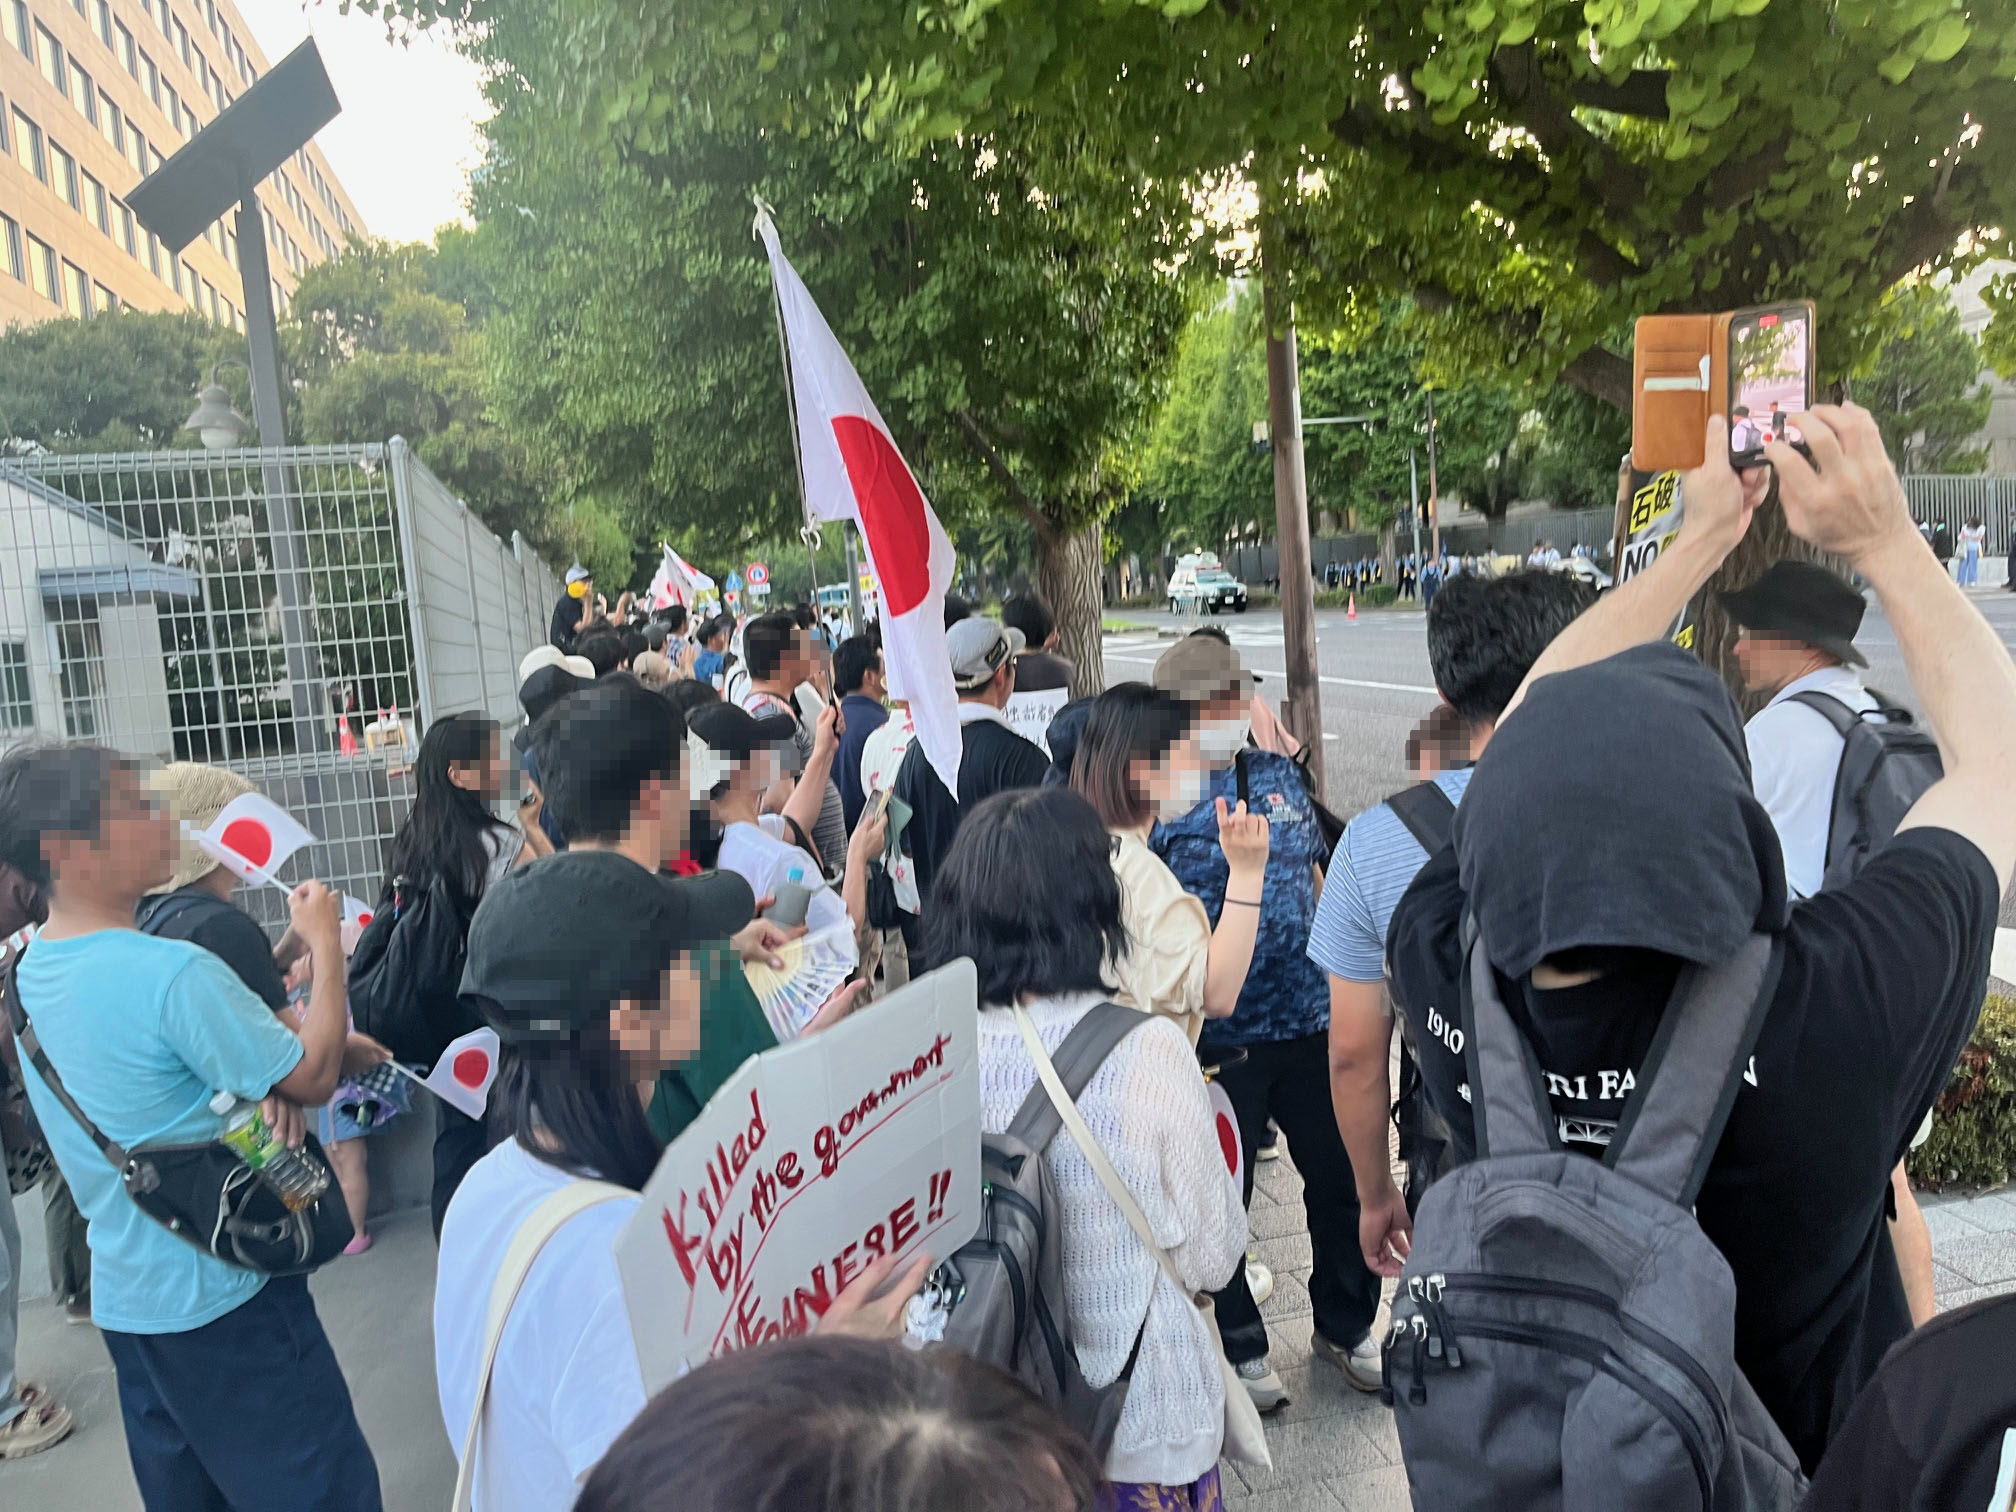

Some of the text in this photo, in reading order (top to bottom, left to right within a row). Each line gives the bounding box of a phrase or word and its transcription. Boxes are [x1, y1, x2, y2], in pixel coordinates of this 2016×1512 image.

[1622, 540, 1659, 583] NO
[1427, 1006, 1464, 1054] 1910
[1541, 1067, 1637, 1100] RI FA
[661, 1087, 767, 1290] Killed
[704, 1212, 744, 1298] by
[749, 1152, 804, 1232] the
